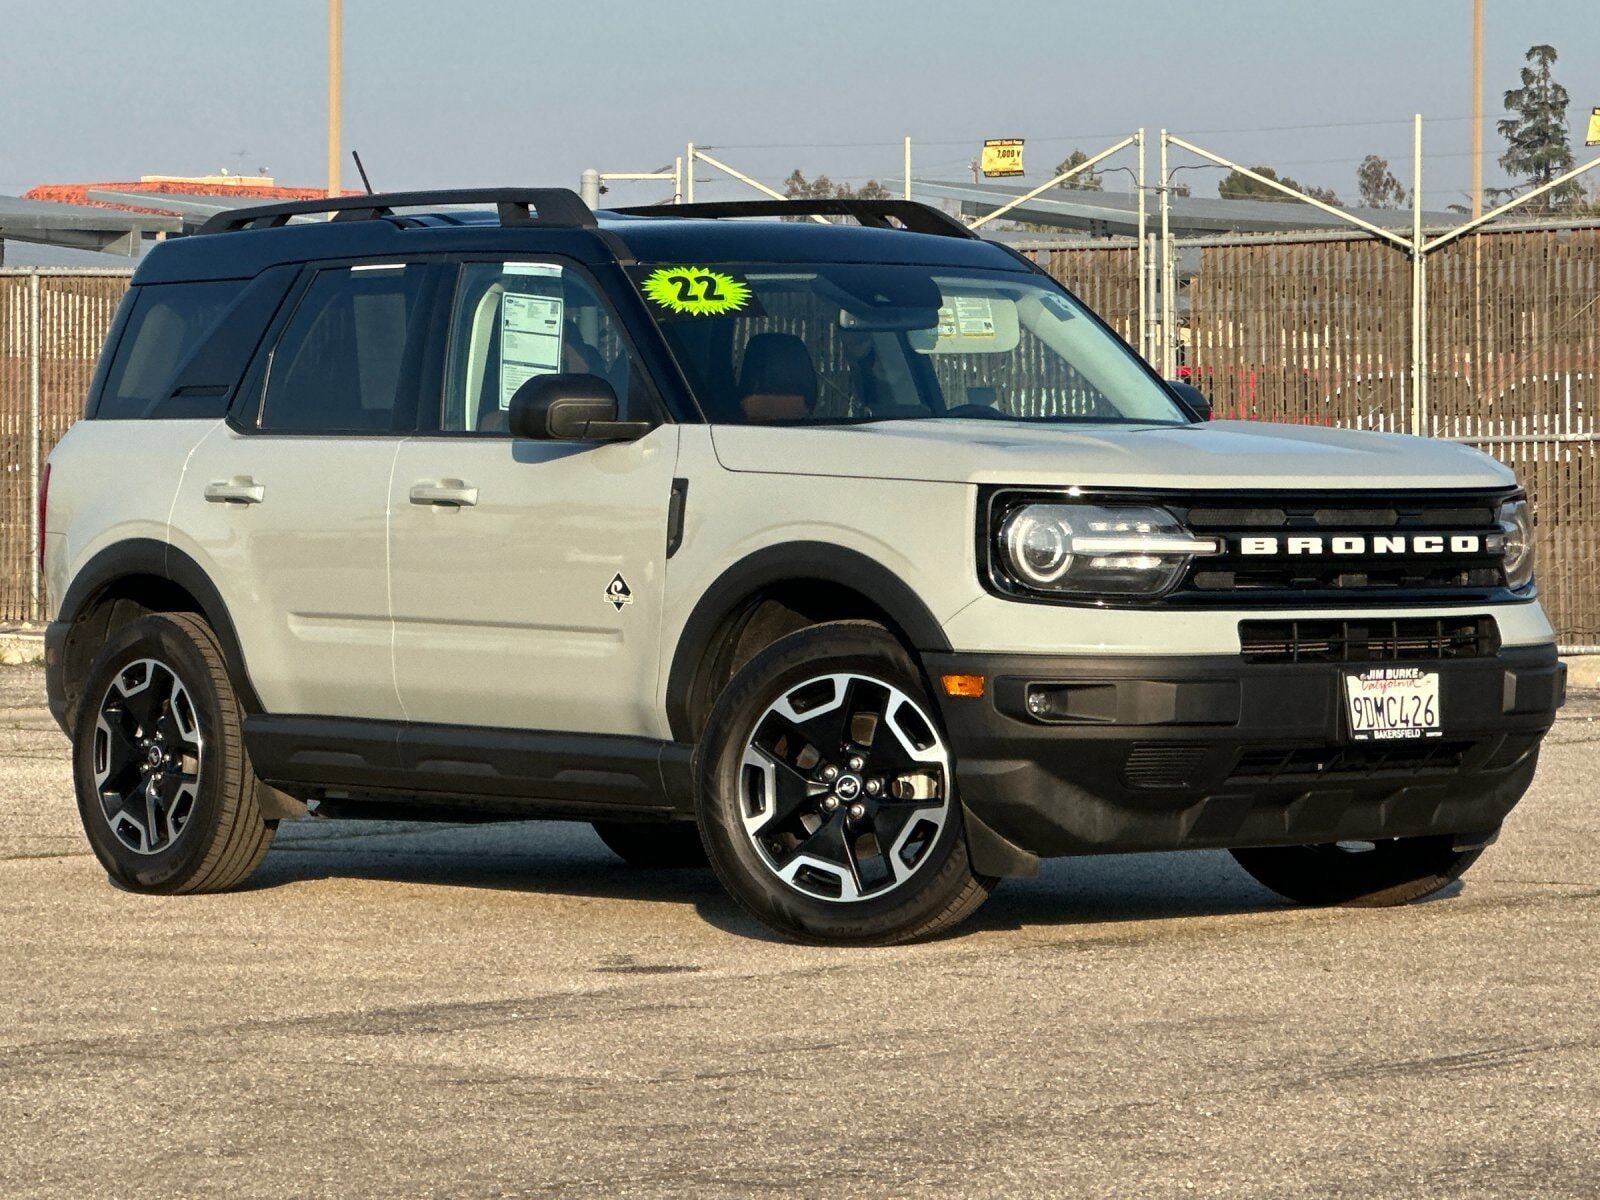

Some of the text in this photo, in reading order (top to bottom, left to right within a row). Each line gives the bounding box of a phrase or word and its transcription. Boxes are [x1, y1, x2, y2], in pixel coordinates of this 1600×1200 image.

[667, 275, 725, 302] 22
[1240, 535, 1480, 555] BRONCO
[1366, 668, 1419, 680] JIM BURKE
[1361, 679, 1422, 694] California
[1353, 694, 1434, 729] 9DMC426
[1373, 728, 1421, 740] BAKERSFIELD
